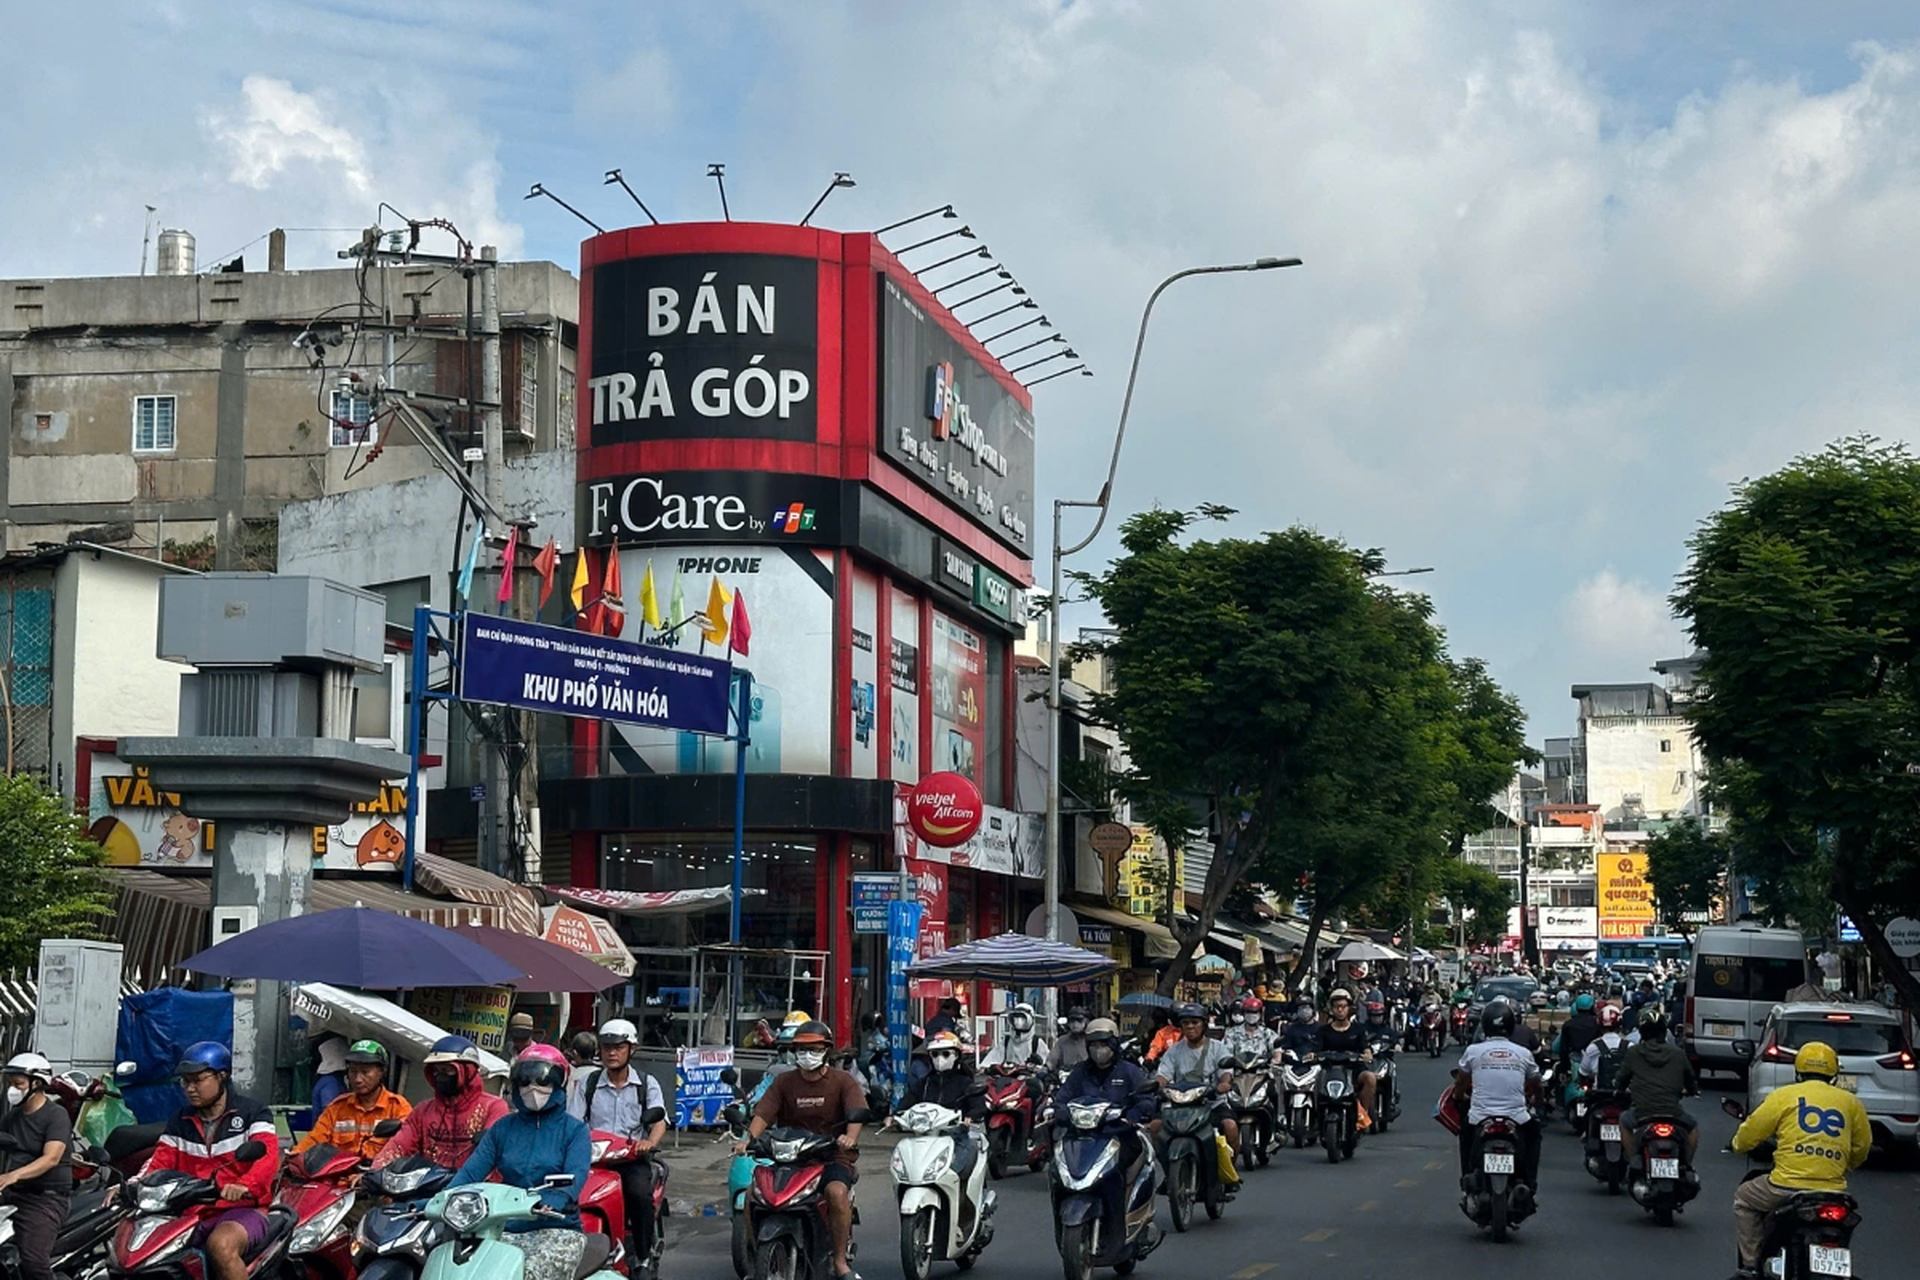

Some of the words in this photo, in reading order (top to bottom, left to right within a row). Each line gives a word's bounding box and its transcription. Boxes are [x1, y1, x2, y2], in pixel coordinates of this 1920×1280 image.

[647, 272, 775, 336] BÁN
[588, 352, 675, 425] TRẢ
[691, 355, 809, 418] GÓP
[588, 478, 746, 537] F.Care
[749, 515, 766, 533] by
[678, 557, 762, 573] IPHONE
[523, 673, 560, 703] KHU
[563, 675, 599, 708] PHỐ
[602, 680, 633, 713] VĂN
[637, 686, 668, 718] HÓA
[1798, 1097, 1845, 1137] be
